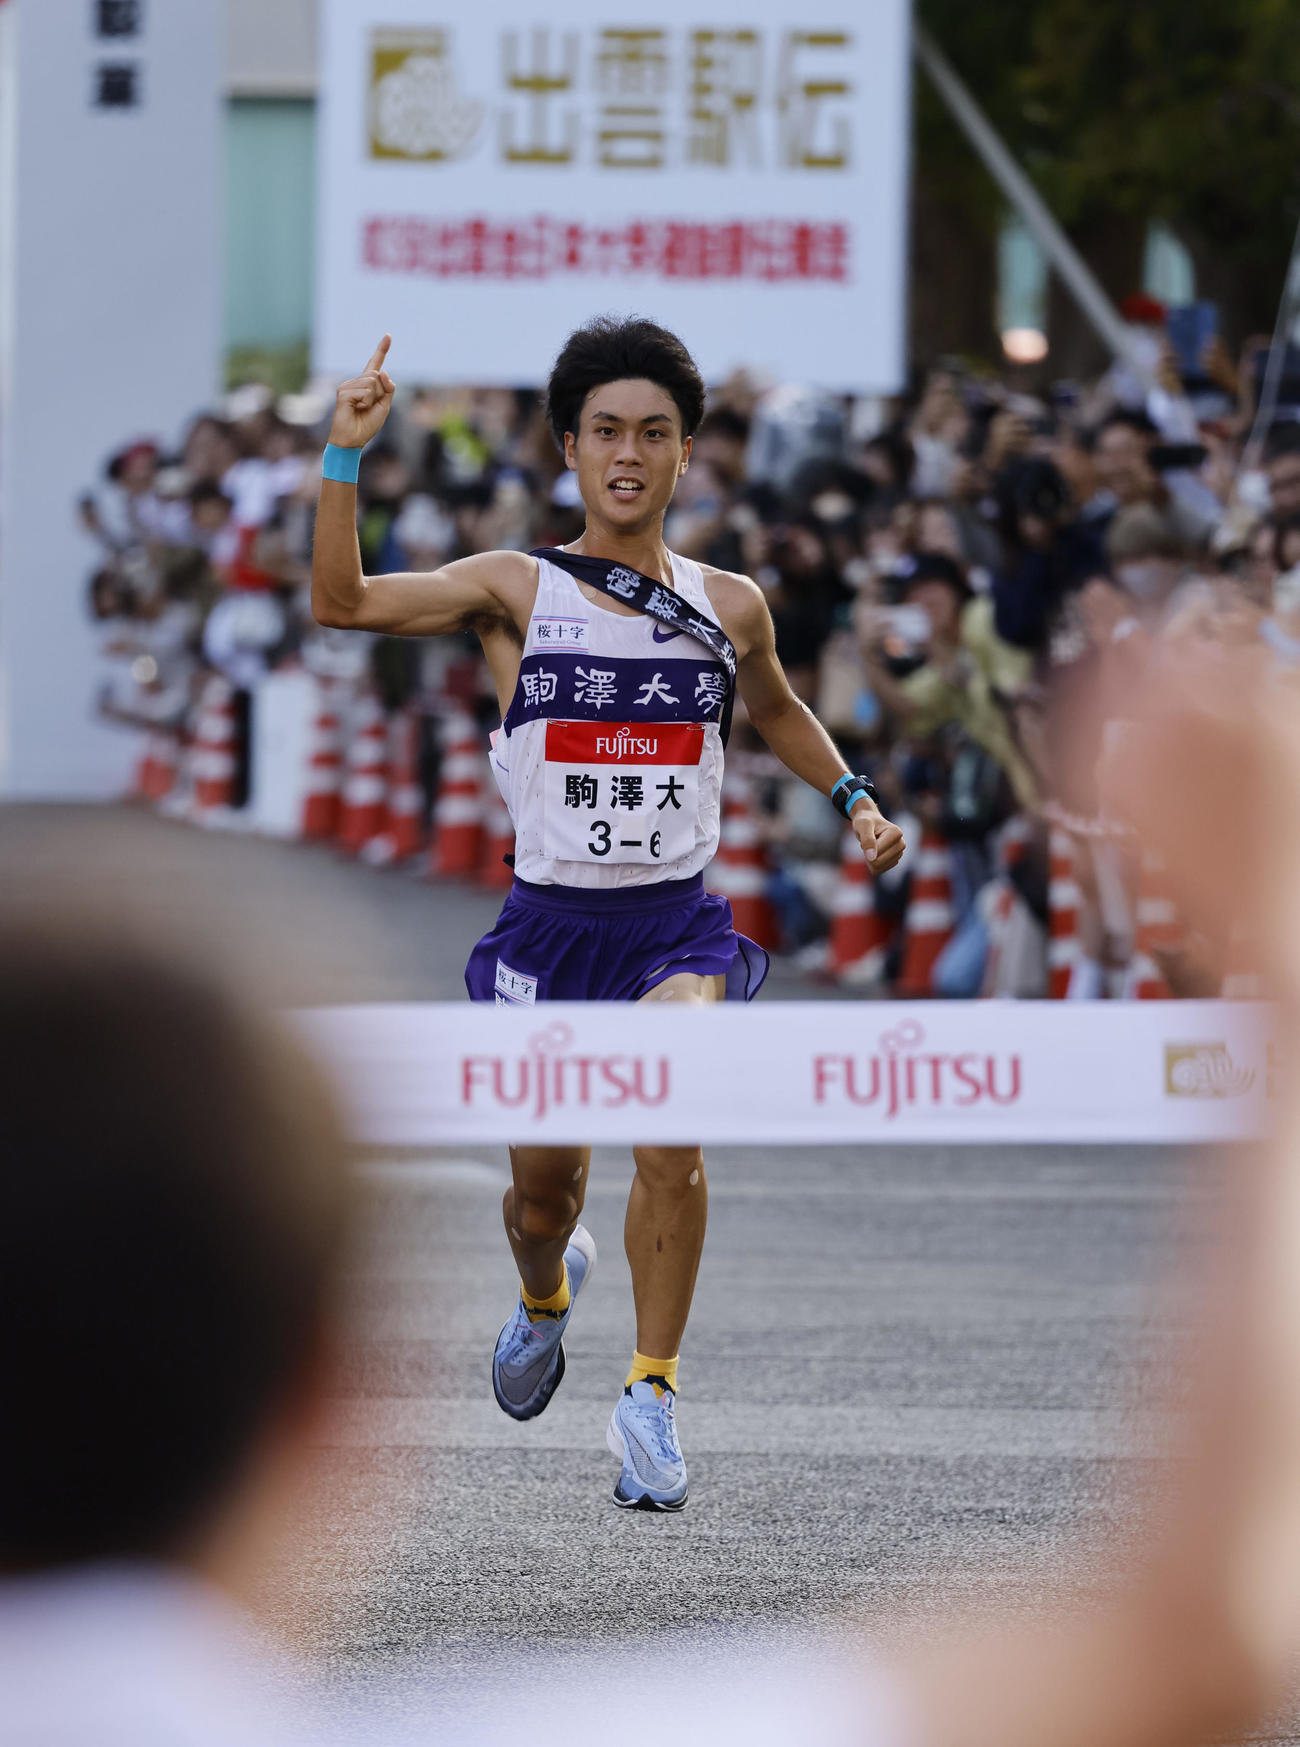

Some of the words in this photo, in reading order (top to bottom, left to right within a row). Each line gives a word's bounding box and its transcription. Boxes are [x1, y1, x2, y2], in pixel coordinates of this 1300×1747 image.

[499, 27, 850, 170] 出雲駅伝
[537, 624, 585, 639] 桜十字
[595, 727, 658, 760] FUJITSU
[564, 774, 685, 811] 駒澤大
[461, 1021, 670, 1122] FUJITSU
[813, 1018, 1021, 1121] FUJITSU
